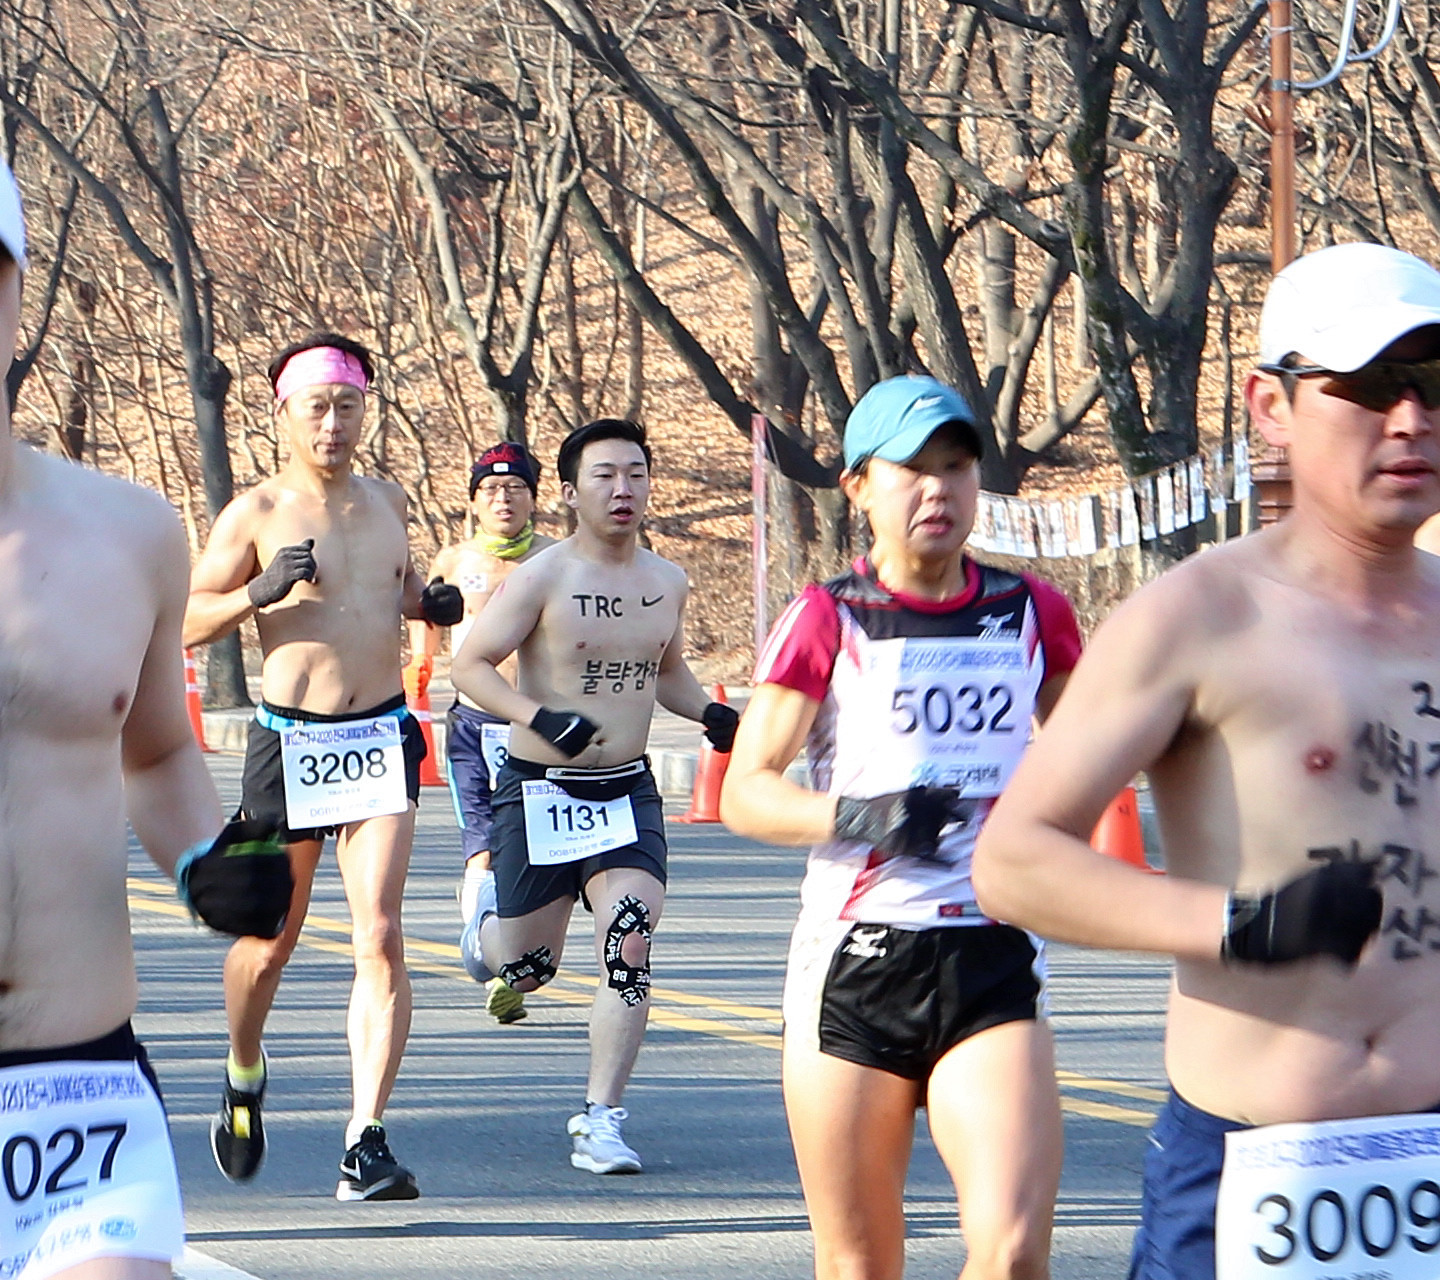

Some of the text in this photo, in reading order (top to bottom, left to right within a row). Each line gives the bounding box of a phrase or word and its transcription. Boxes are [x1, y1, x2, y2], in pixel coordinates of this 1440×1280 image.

[572, 594, 623, 618] TRC
[891, 683, 1015, 734] 5032
[299, 748, 387, 786] 3208
[547, 804, 609, 832] 1131
